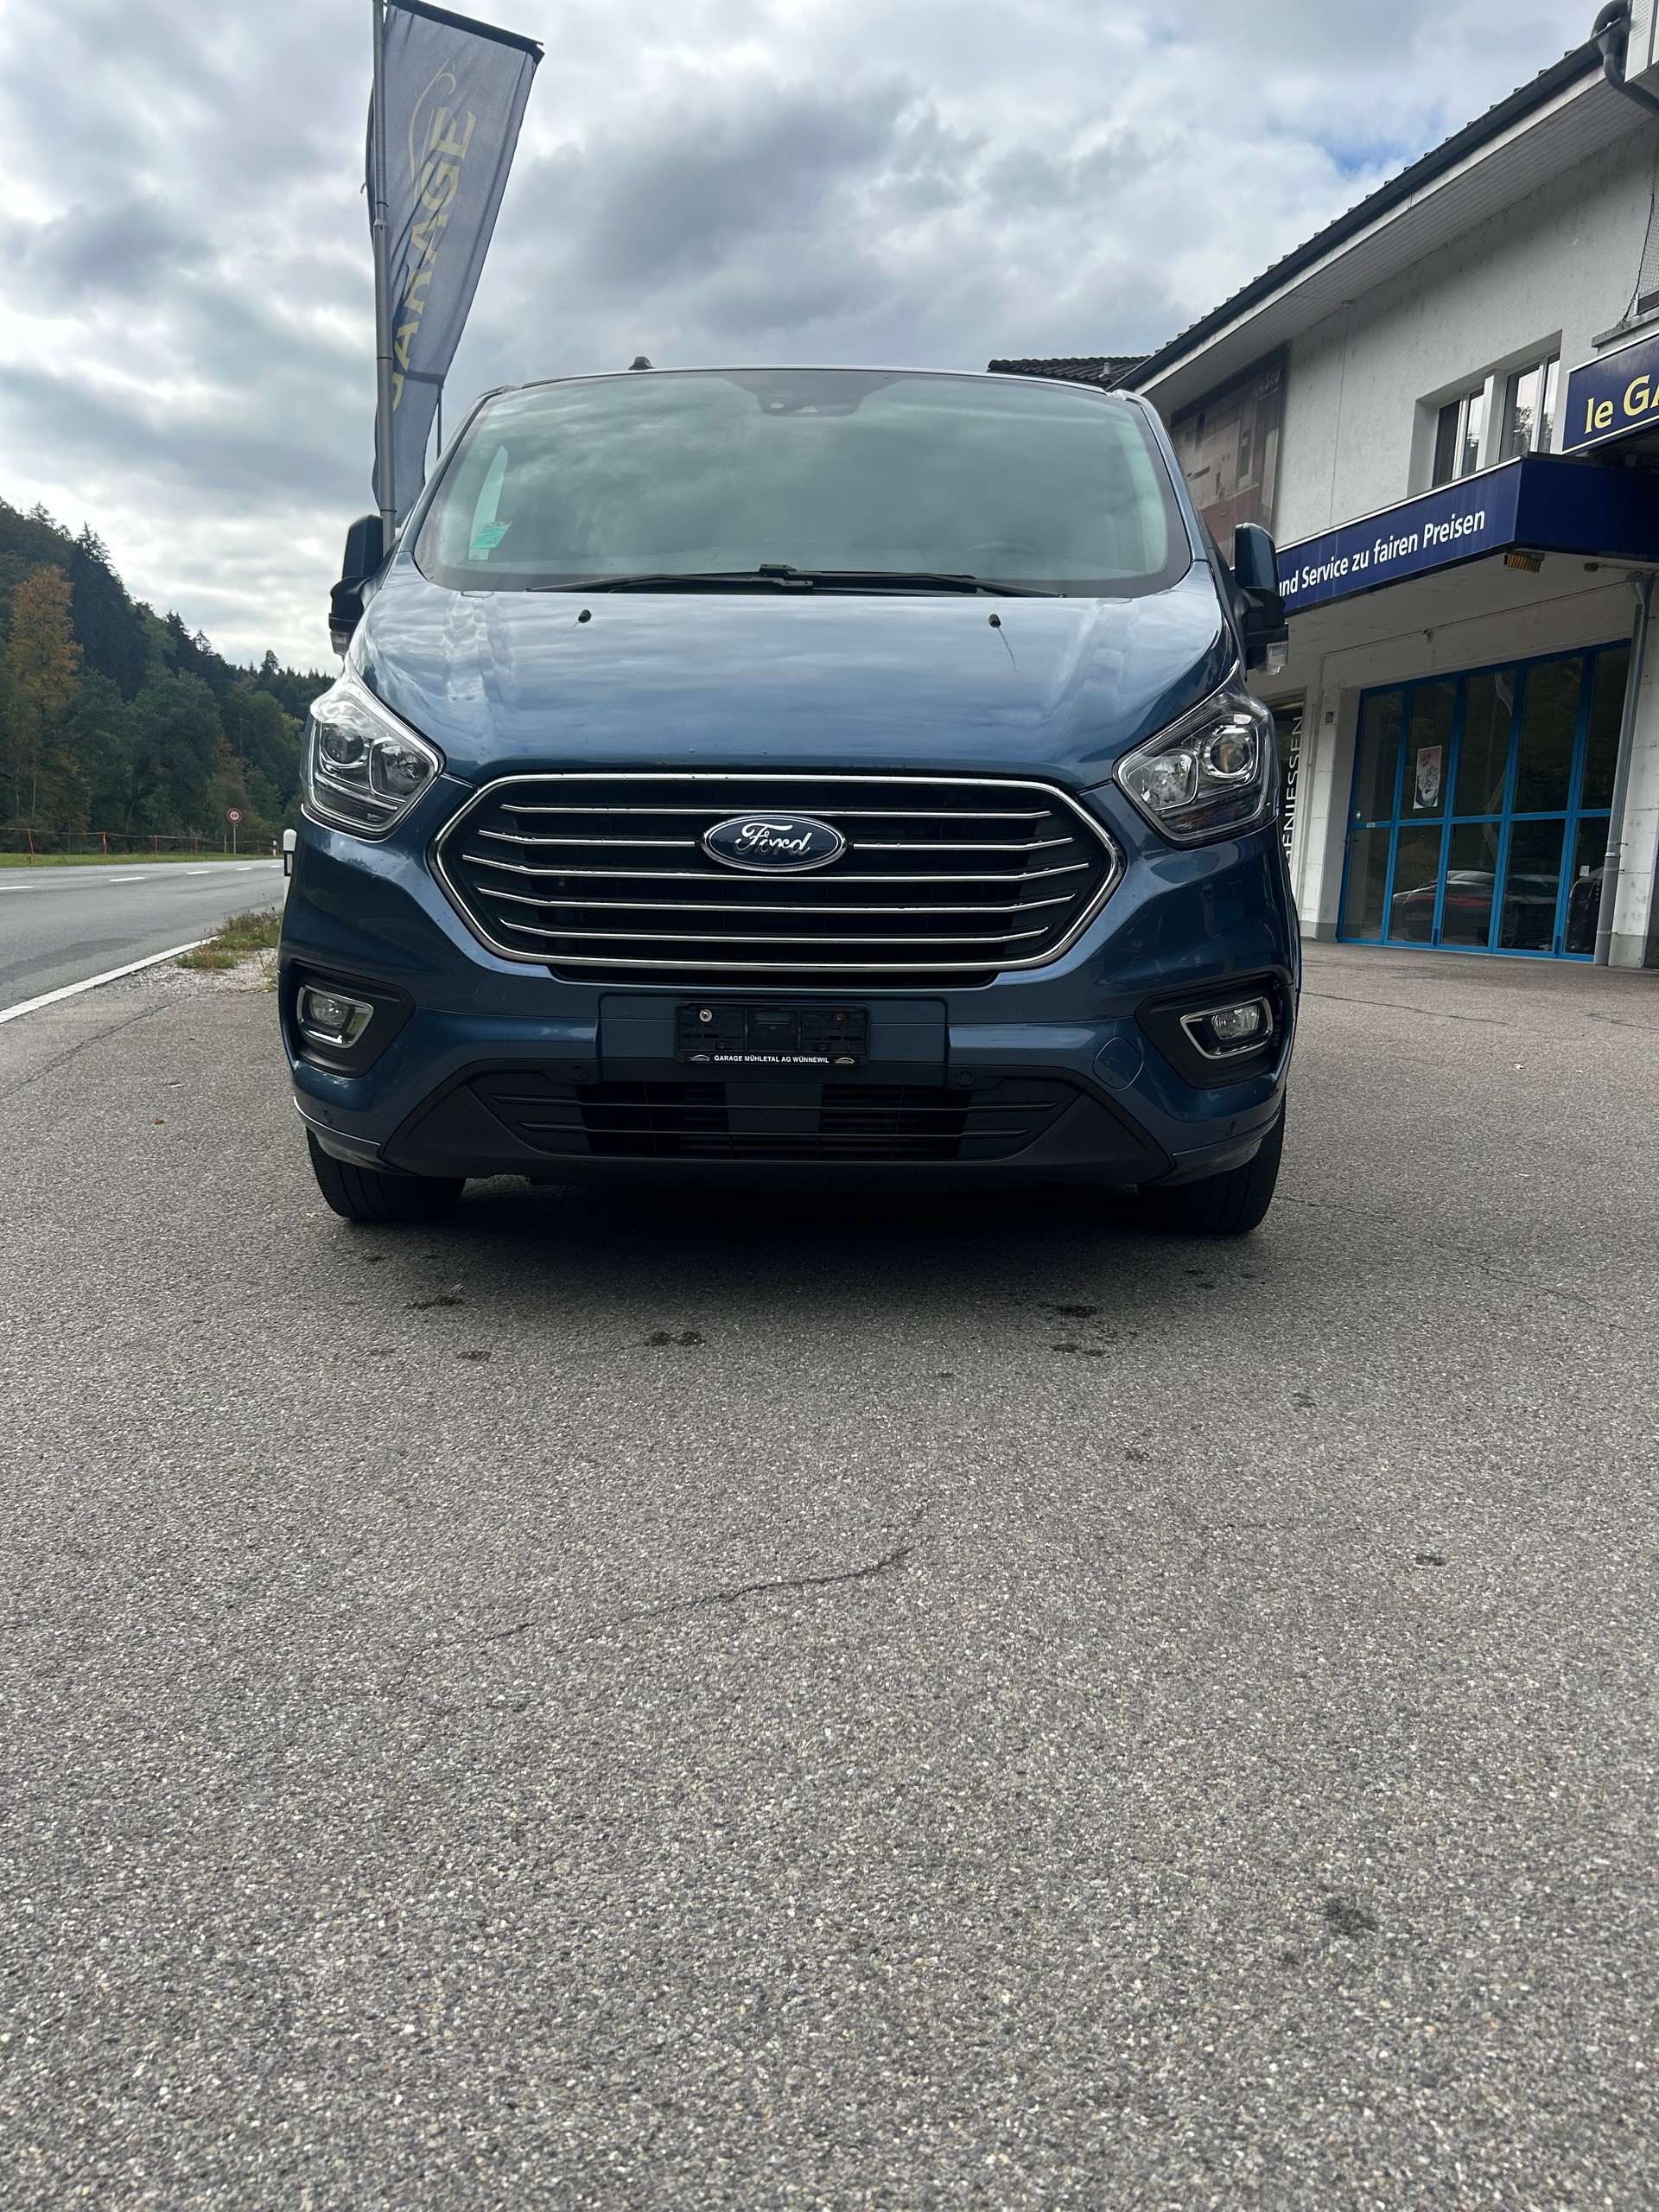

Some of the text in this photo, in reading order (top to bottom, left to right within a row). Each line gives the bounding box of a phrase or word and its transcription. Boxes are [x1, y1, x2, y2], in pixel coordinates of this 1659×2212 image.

[1584, 374, 1659, 434] le G
[1301, 556, 1349, 589] Service
[1351, 550, 1370, 572] zu
[1373, 533, 1418, 564] fairen
[1422, 510, 1485, 549] Preisen
[734, 823, 813, 855] Ford
[744, 1054, 780, 1063] MÜHLETAL
